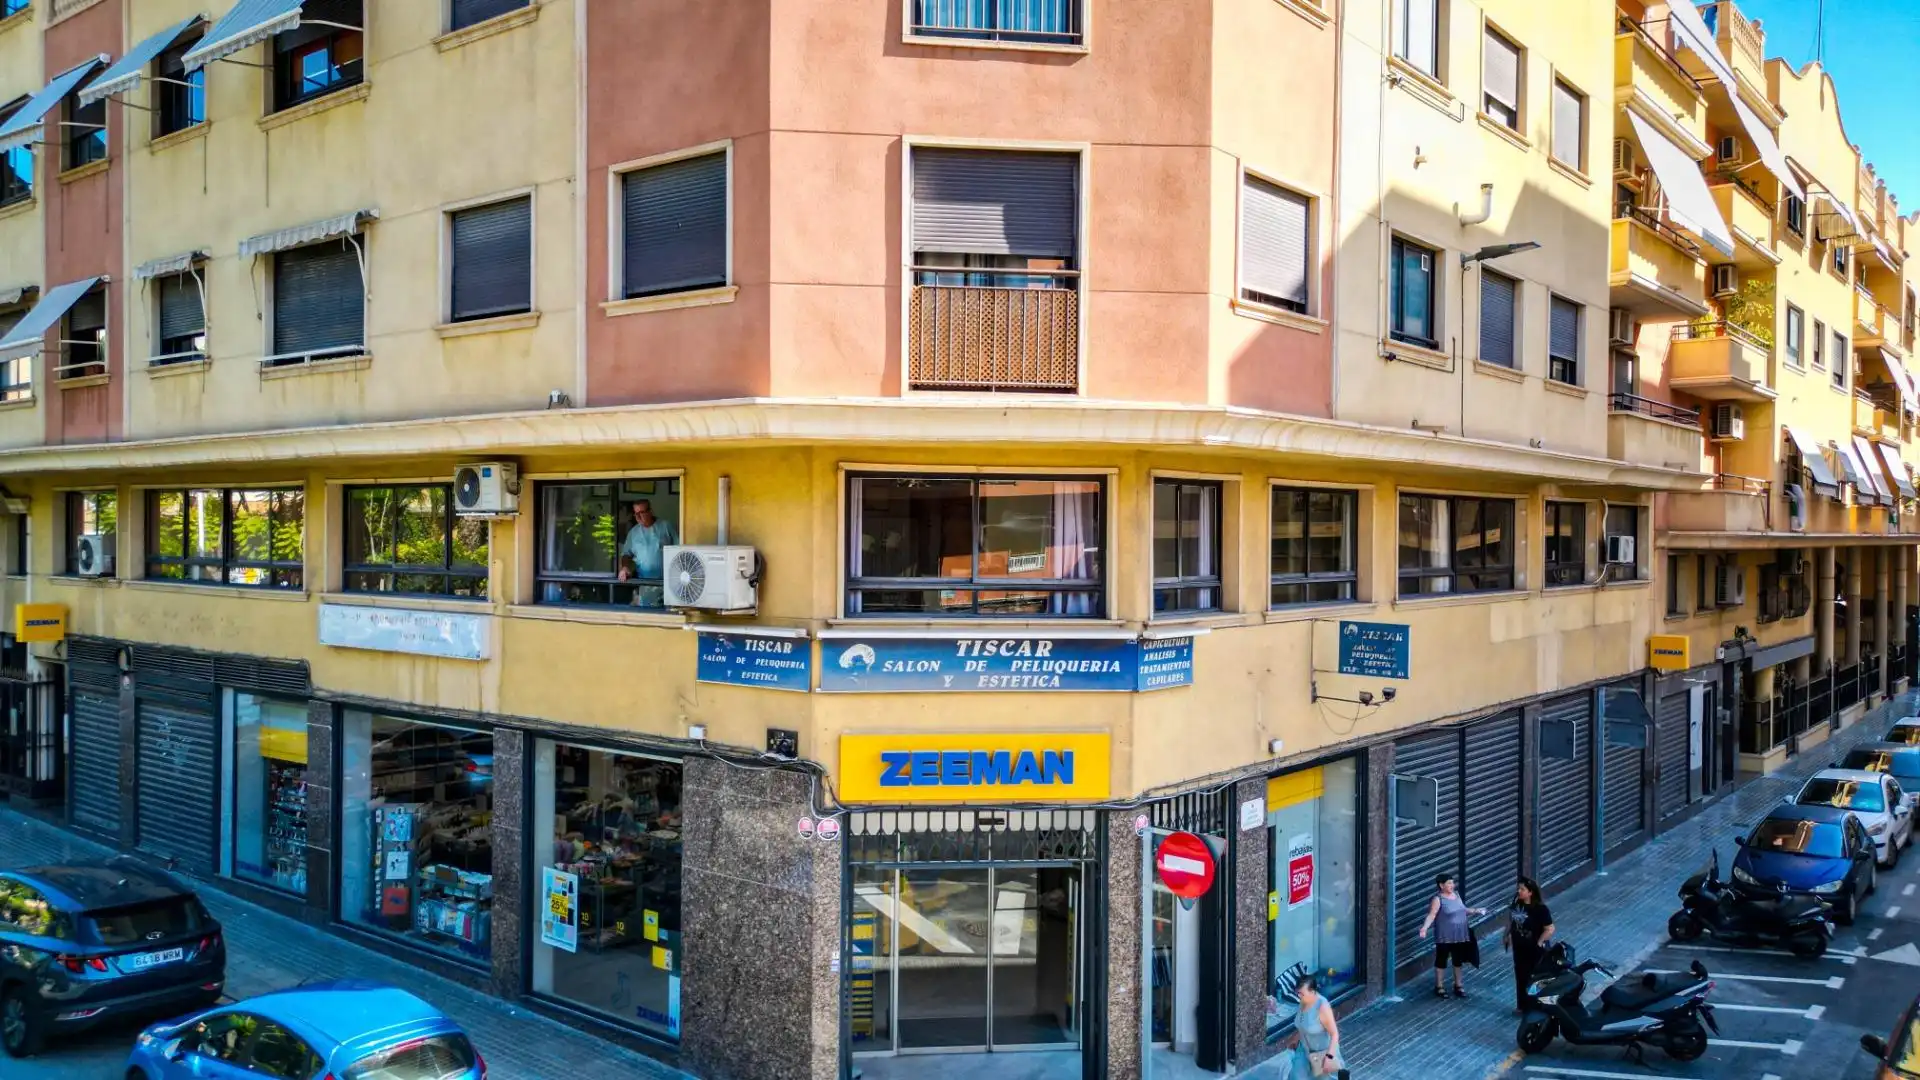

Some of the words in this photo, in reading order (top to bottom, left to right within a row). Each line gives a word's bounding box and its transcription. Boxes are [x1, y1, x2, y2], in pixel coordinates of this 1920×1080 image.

[744, 639, 793, 654] TISCAR
[956, 639, 1053, 657] TISCAR
[702, 654, 727, 663] SALON
[735, 656, 747, 665] DE
[755, 658, 805, 670] PELUQUERIA
[1143, 649, 1177, 662] ANALISIS
[1183, 648, 1188, 657] Y
[882, 660, 941, 673] SALON
[964, 660, 988, 672] DE
[1010, 660, 1121, 675] PELUQUERIA
[1139, 660, 1191, 675] TRATAMIENTOS
[726, 669, 733, 678] Y
[741, 671, 778, 682] ESTETICA
[943, 674, 954, 688] Y
[977, 675, 1061, 688] ESTETICA
[1146, 672, 1185, 686] CAPILARES
[879, 749, 1075, 787] ZEEMAN
[1289, 845, 1314, 859] rebajas
[1292, 870, 1310, 888] 50%
[551, 899, 568, 913] 25%
